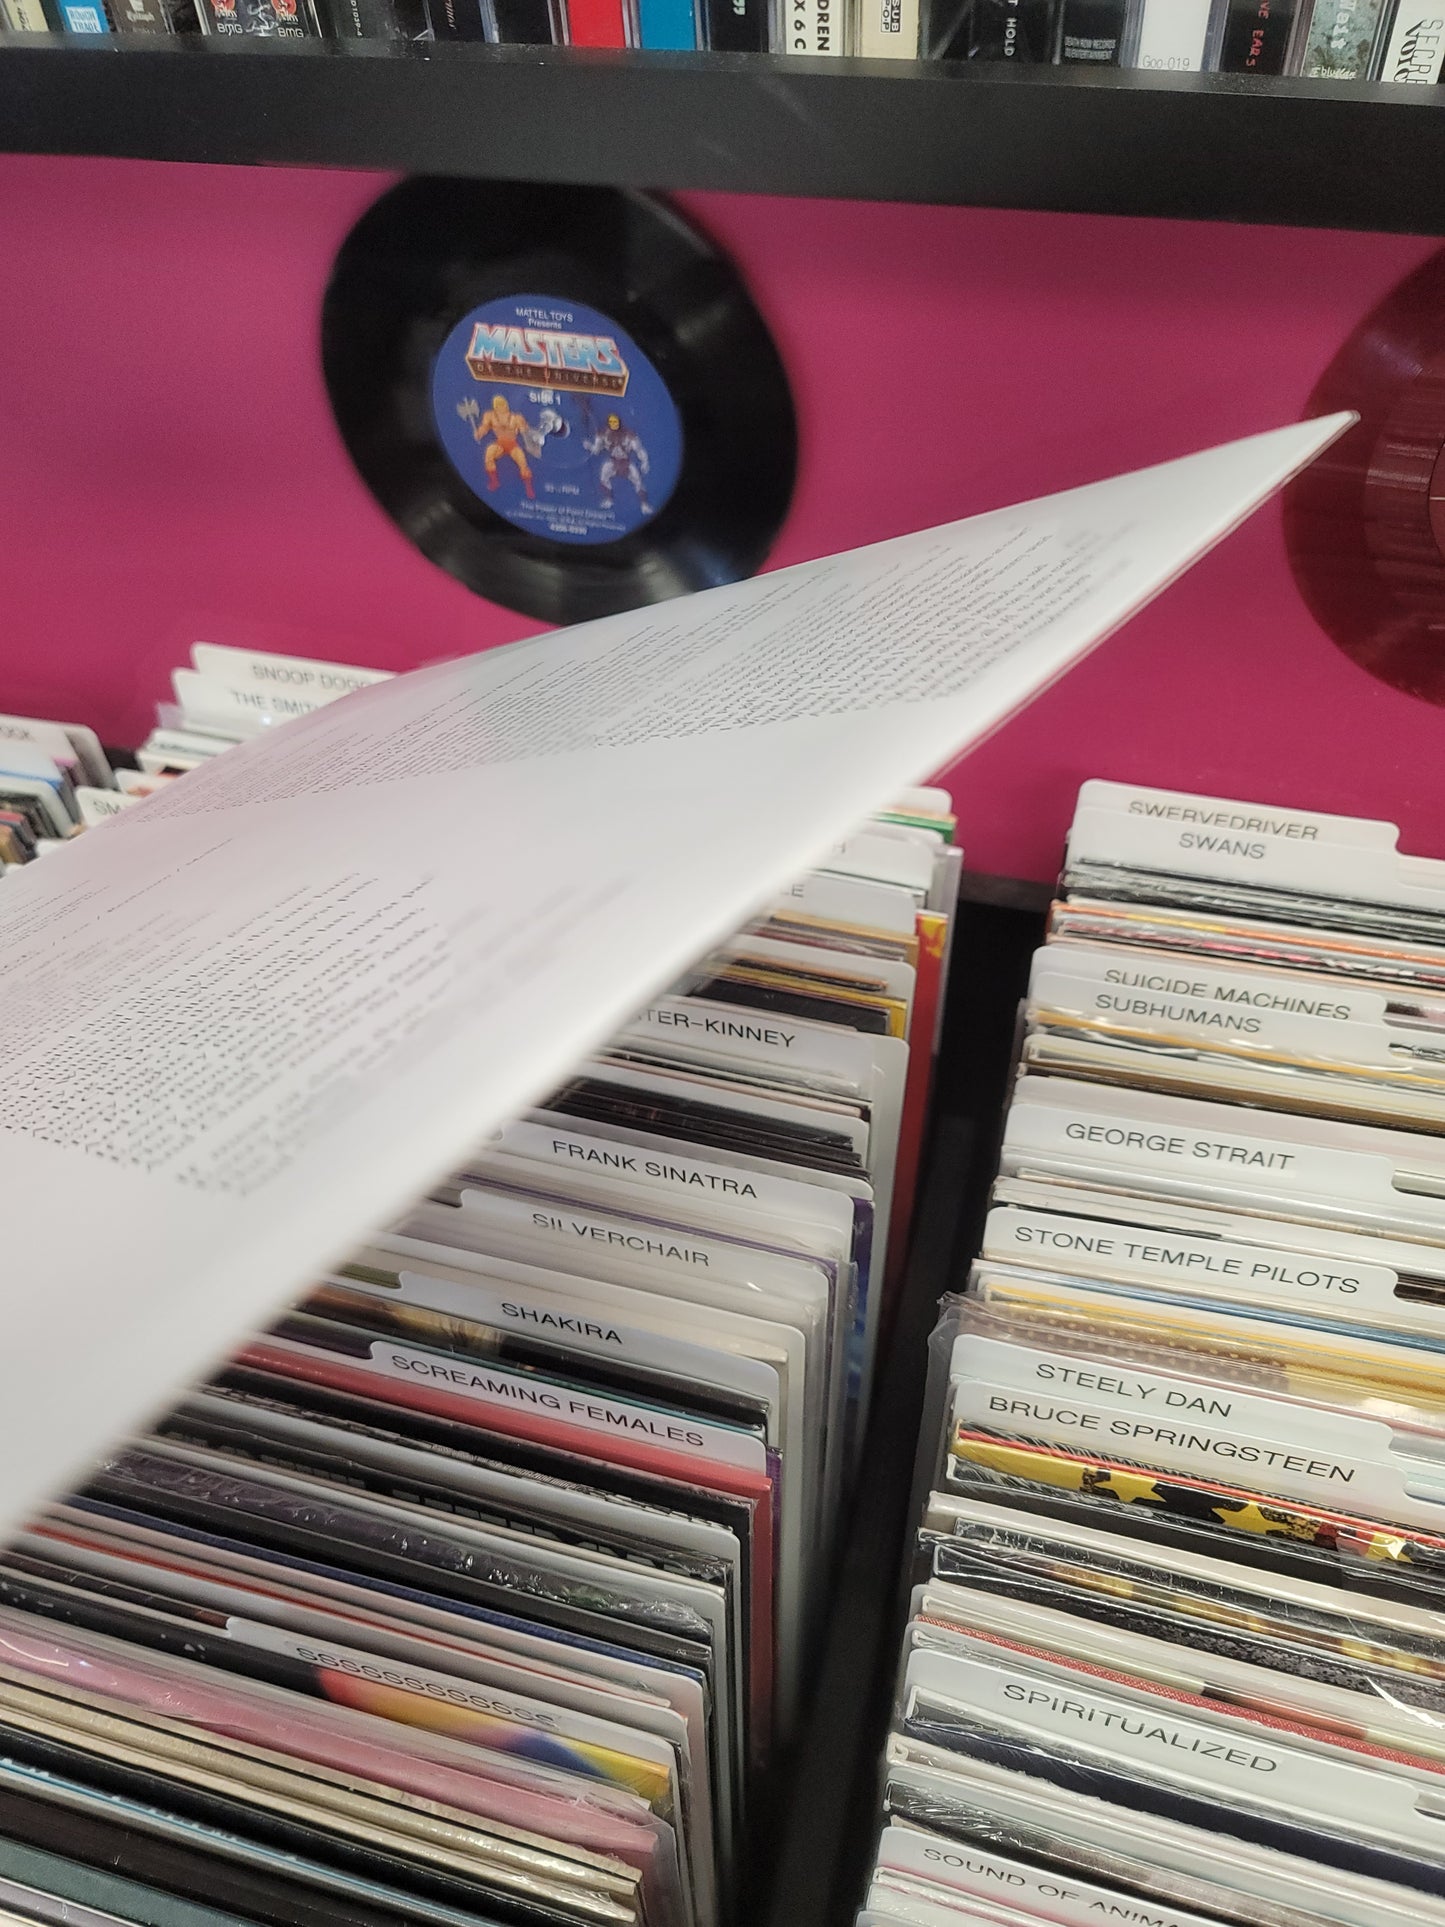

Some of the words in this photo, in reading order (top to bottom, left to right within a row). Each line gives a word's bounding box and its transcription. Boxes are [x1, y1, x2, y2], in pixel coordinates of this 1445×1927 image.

[217, 23, 243, 35] BMG
[278, 28, 304, 38] BMG
[1003, 17, 1017, 57] HOLD
[516, 307, 549, 320] MATTEL
[550, 311, 574, 323] TOYS
[472, 323, 625, 377] MASTERS
[252, 664, 315, 686] SNOOP
[231, 689, 267, 710] THE
[271, 697, 319, 715] SMIT
[1128, 800, 1319, 842] SWERVEDRIVER
[1178, 832, 1266, 860] SWANS
[1094, 994, 1262, 1034] SUBHUMANS
[1104, 969, 1208, 999] SUICIDE
[1213, 985, 1352, 1021] MACHINES
[553, 1140, 637, 1172] FRANK
[645, 1161, 758, 1199] SINATRA
[1065, 1122, 1185, 1155] GEORGE
[1191, 1140, 1296, 1171] STRAIT
[532, 1212, 711, 1267] SILVERCHAIR
[1014, 1225, 1115, 1256] STONE
[1123, 1241, 1243, 1276] TEMPLE
[1250, 1262, 1361, 1295] PILOTS
[501, 1302, 623, 1345] SHAKIRA
[391, 1353, 562, 1411] SCREAMING
[569, 1401, 705, 1447] FEMALES
[1036, 1362, 1158, 1400] STEELY
[1165, 1389, 1233, 1418] DAN
[988, 1395, 1101, 1431] BRUCE
[1108, 1419, 1357, 1483] SPRINGSTEEN
[1002, 1682, 1279, 1774] SPIRITUALIZED
[923, 1847, 1026, 1887] SOUND
[1037, 1883, 1081, 1901] OF
[1089, 1900, 1180, 1927] ANIM
